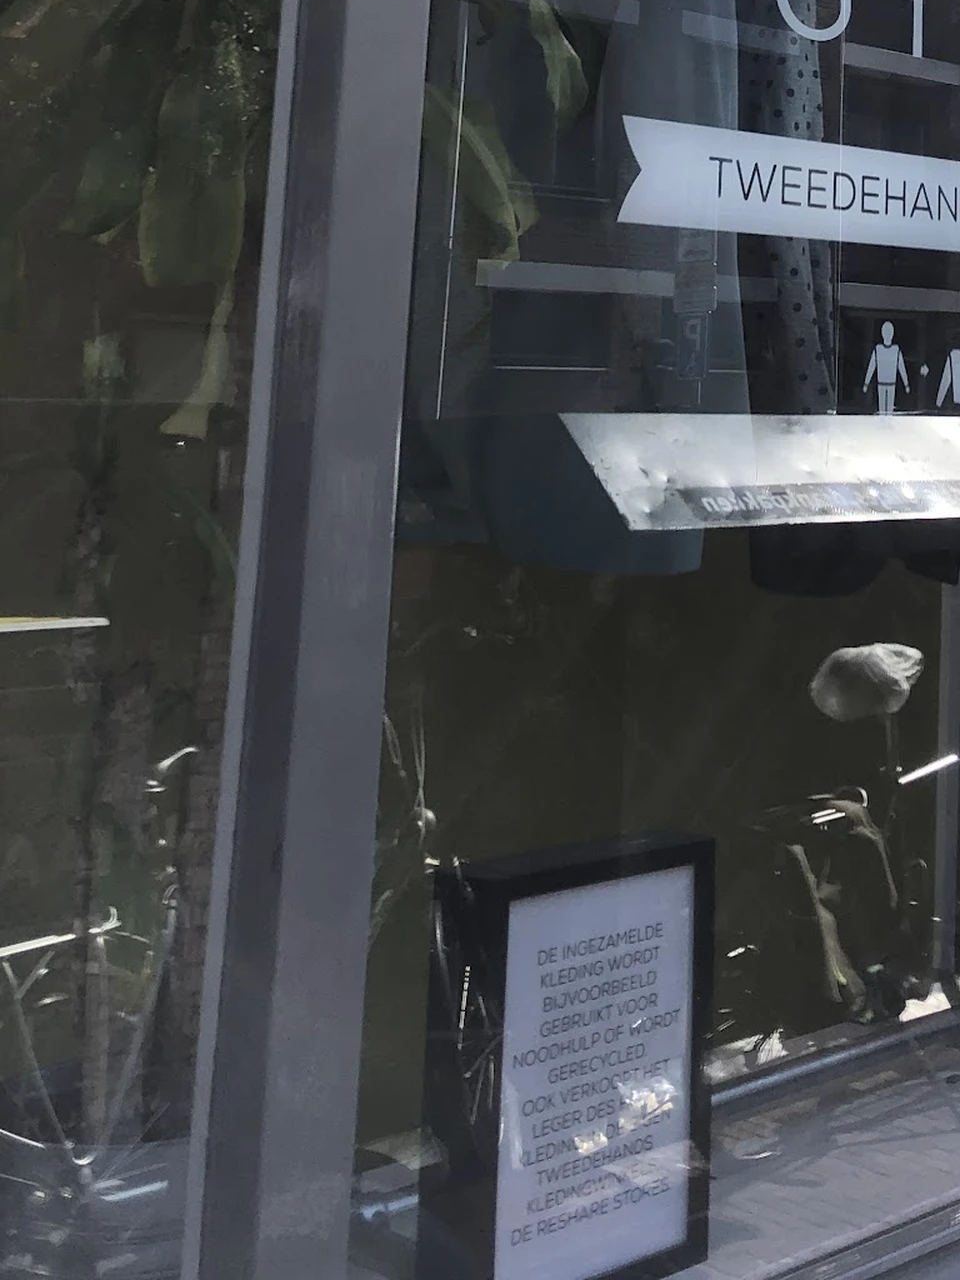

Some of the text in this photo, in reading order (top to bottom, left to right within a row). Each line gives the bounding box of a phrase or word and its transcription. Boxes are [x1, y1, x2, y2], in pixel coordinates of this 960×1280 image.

[537, 922, 664, 967] DE INGEZAMELDE
[540, 946, 660, 989] KLEDING WORDT
[542, 970, 657, 1013] BIJVOORBEELD
[539, 992, 659, 1038] GEBRUIKT VOOR
[512, 1008, 681, 1070] NOODHULP OF WORDT
[521, 1094, 555, 1118] OOK
[532, 1109, 582, 1140] LEGER
[586, 1099, 615, 1123] DES
[537, 1135, 653, 1187] TWEEDEHANDS
[510, 1226, 532, 1247] DE
[536, 1197, 609, 1237] RESHARE
